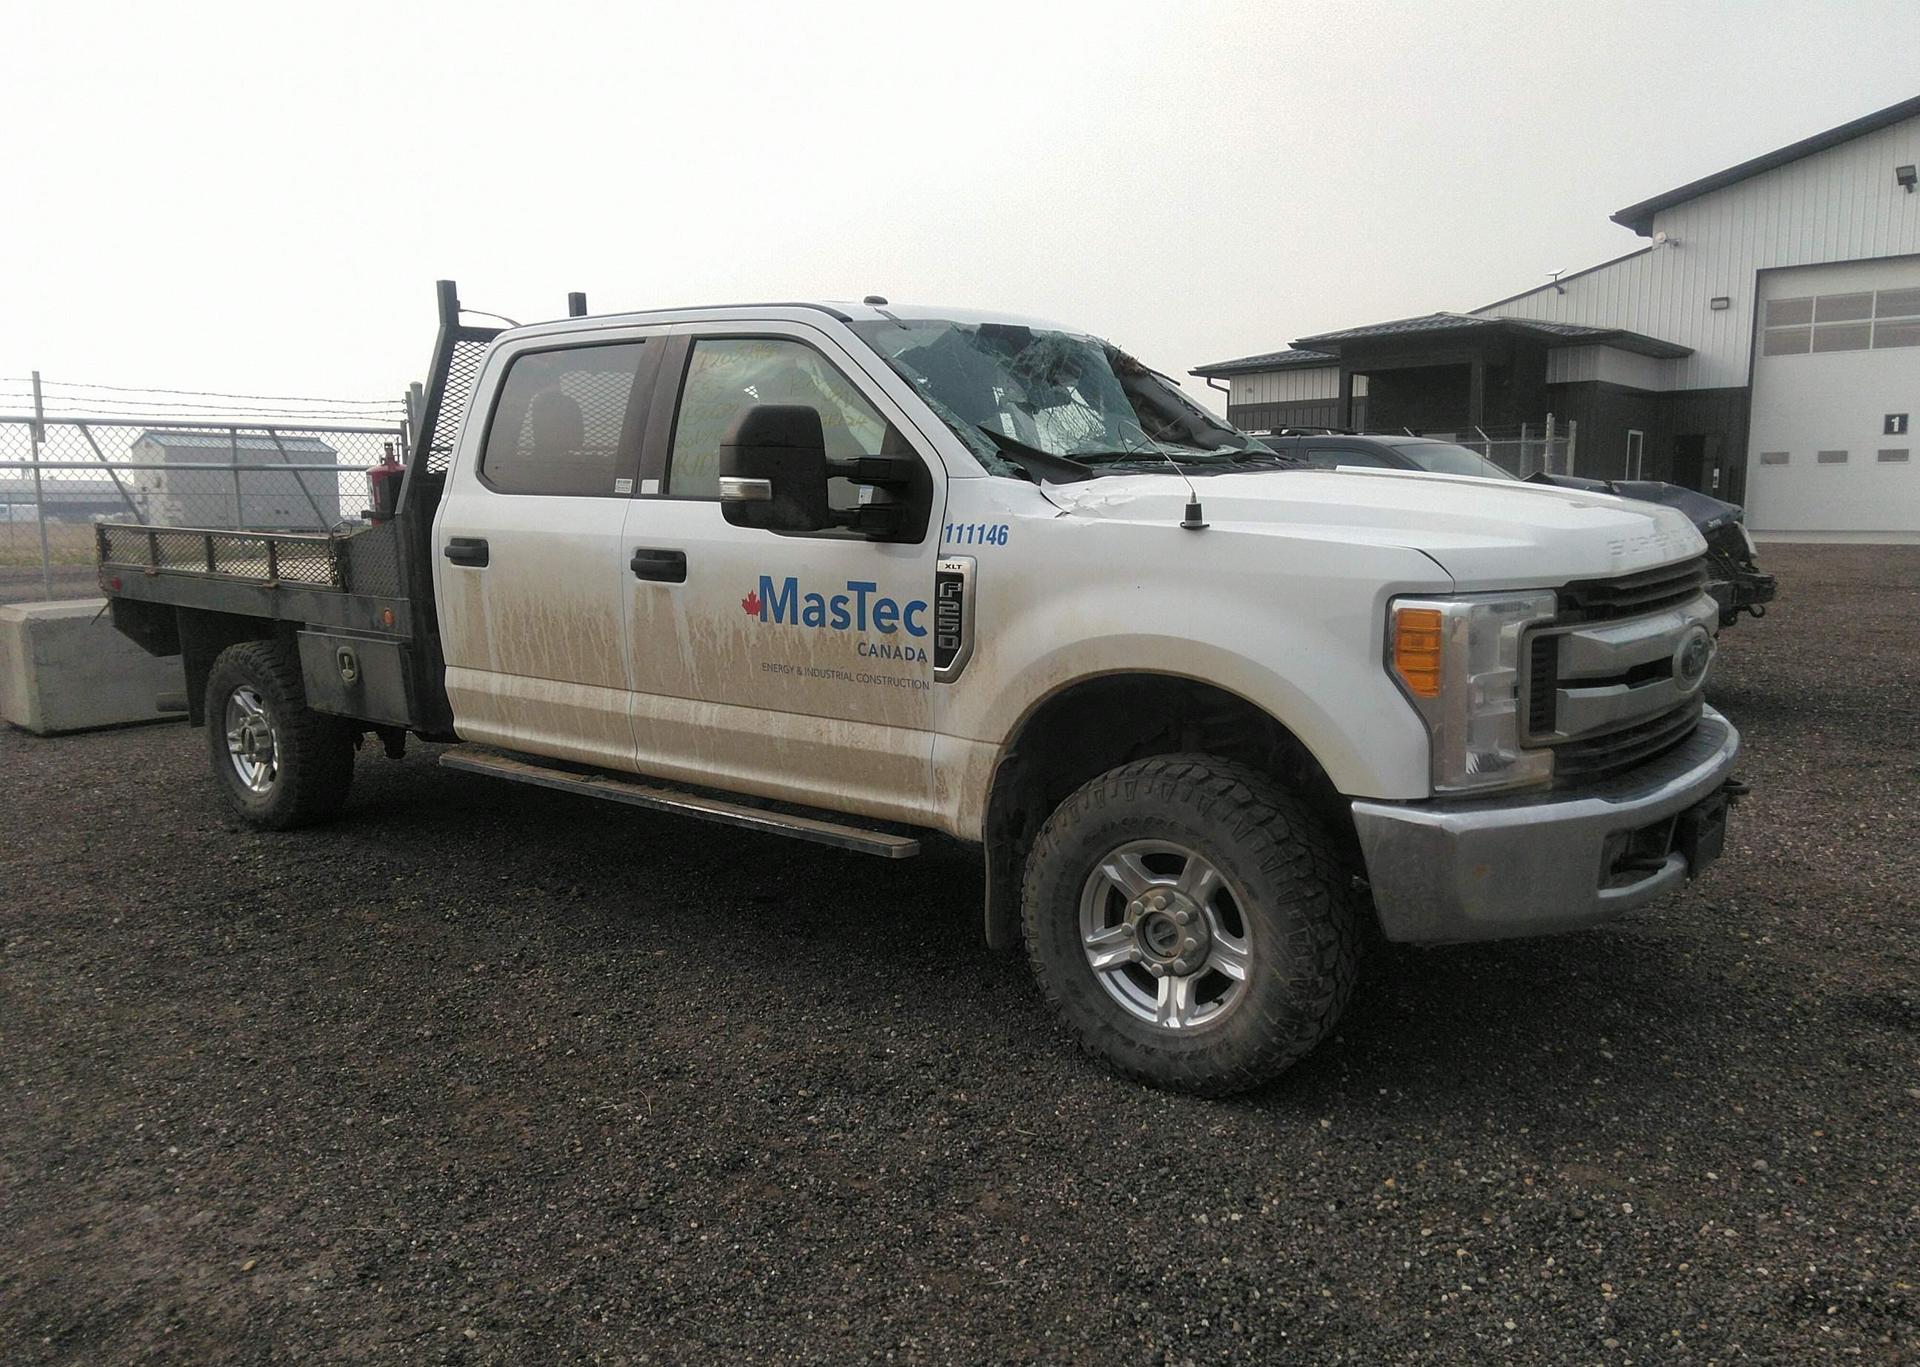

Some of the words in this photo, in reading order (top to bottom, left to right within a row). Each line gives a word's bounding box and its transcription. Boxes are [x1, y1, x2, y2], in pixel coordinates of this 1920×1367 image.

[1891, 416, 1900, 432] 1
[945, 523, 1009, 546] 111146
[944, 563, 963, 571] XLT
[759, 575, 928, 638] MasTec
[857, 642, 928, 664] CANADA
[761, 662, 794, 674] ENERGY
[796, 666, 802, 676] &
[804, 667, 854, 682] INDUSTRIAL
[856, 673, 930, 690] CONSTRUCTION
